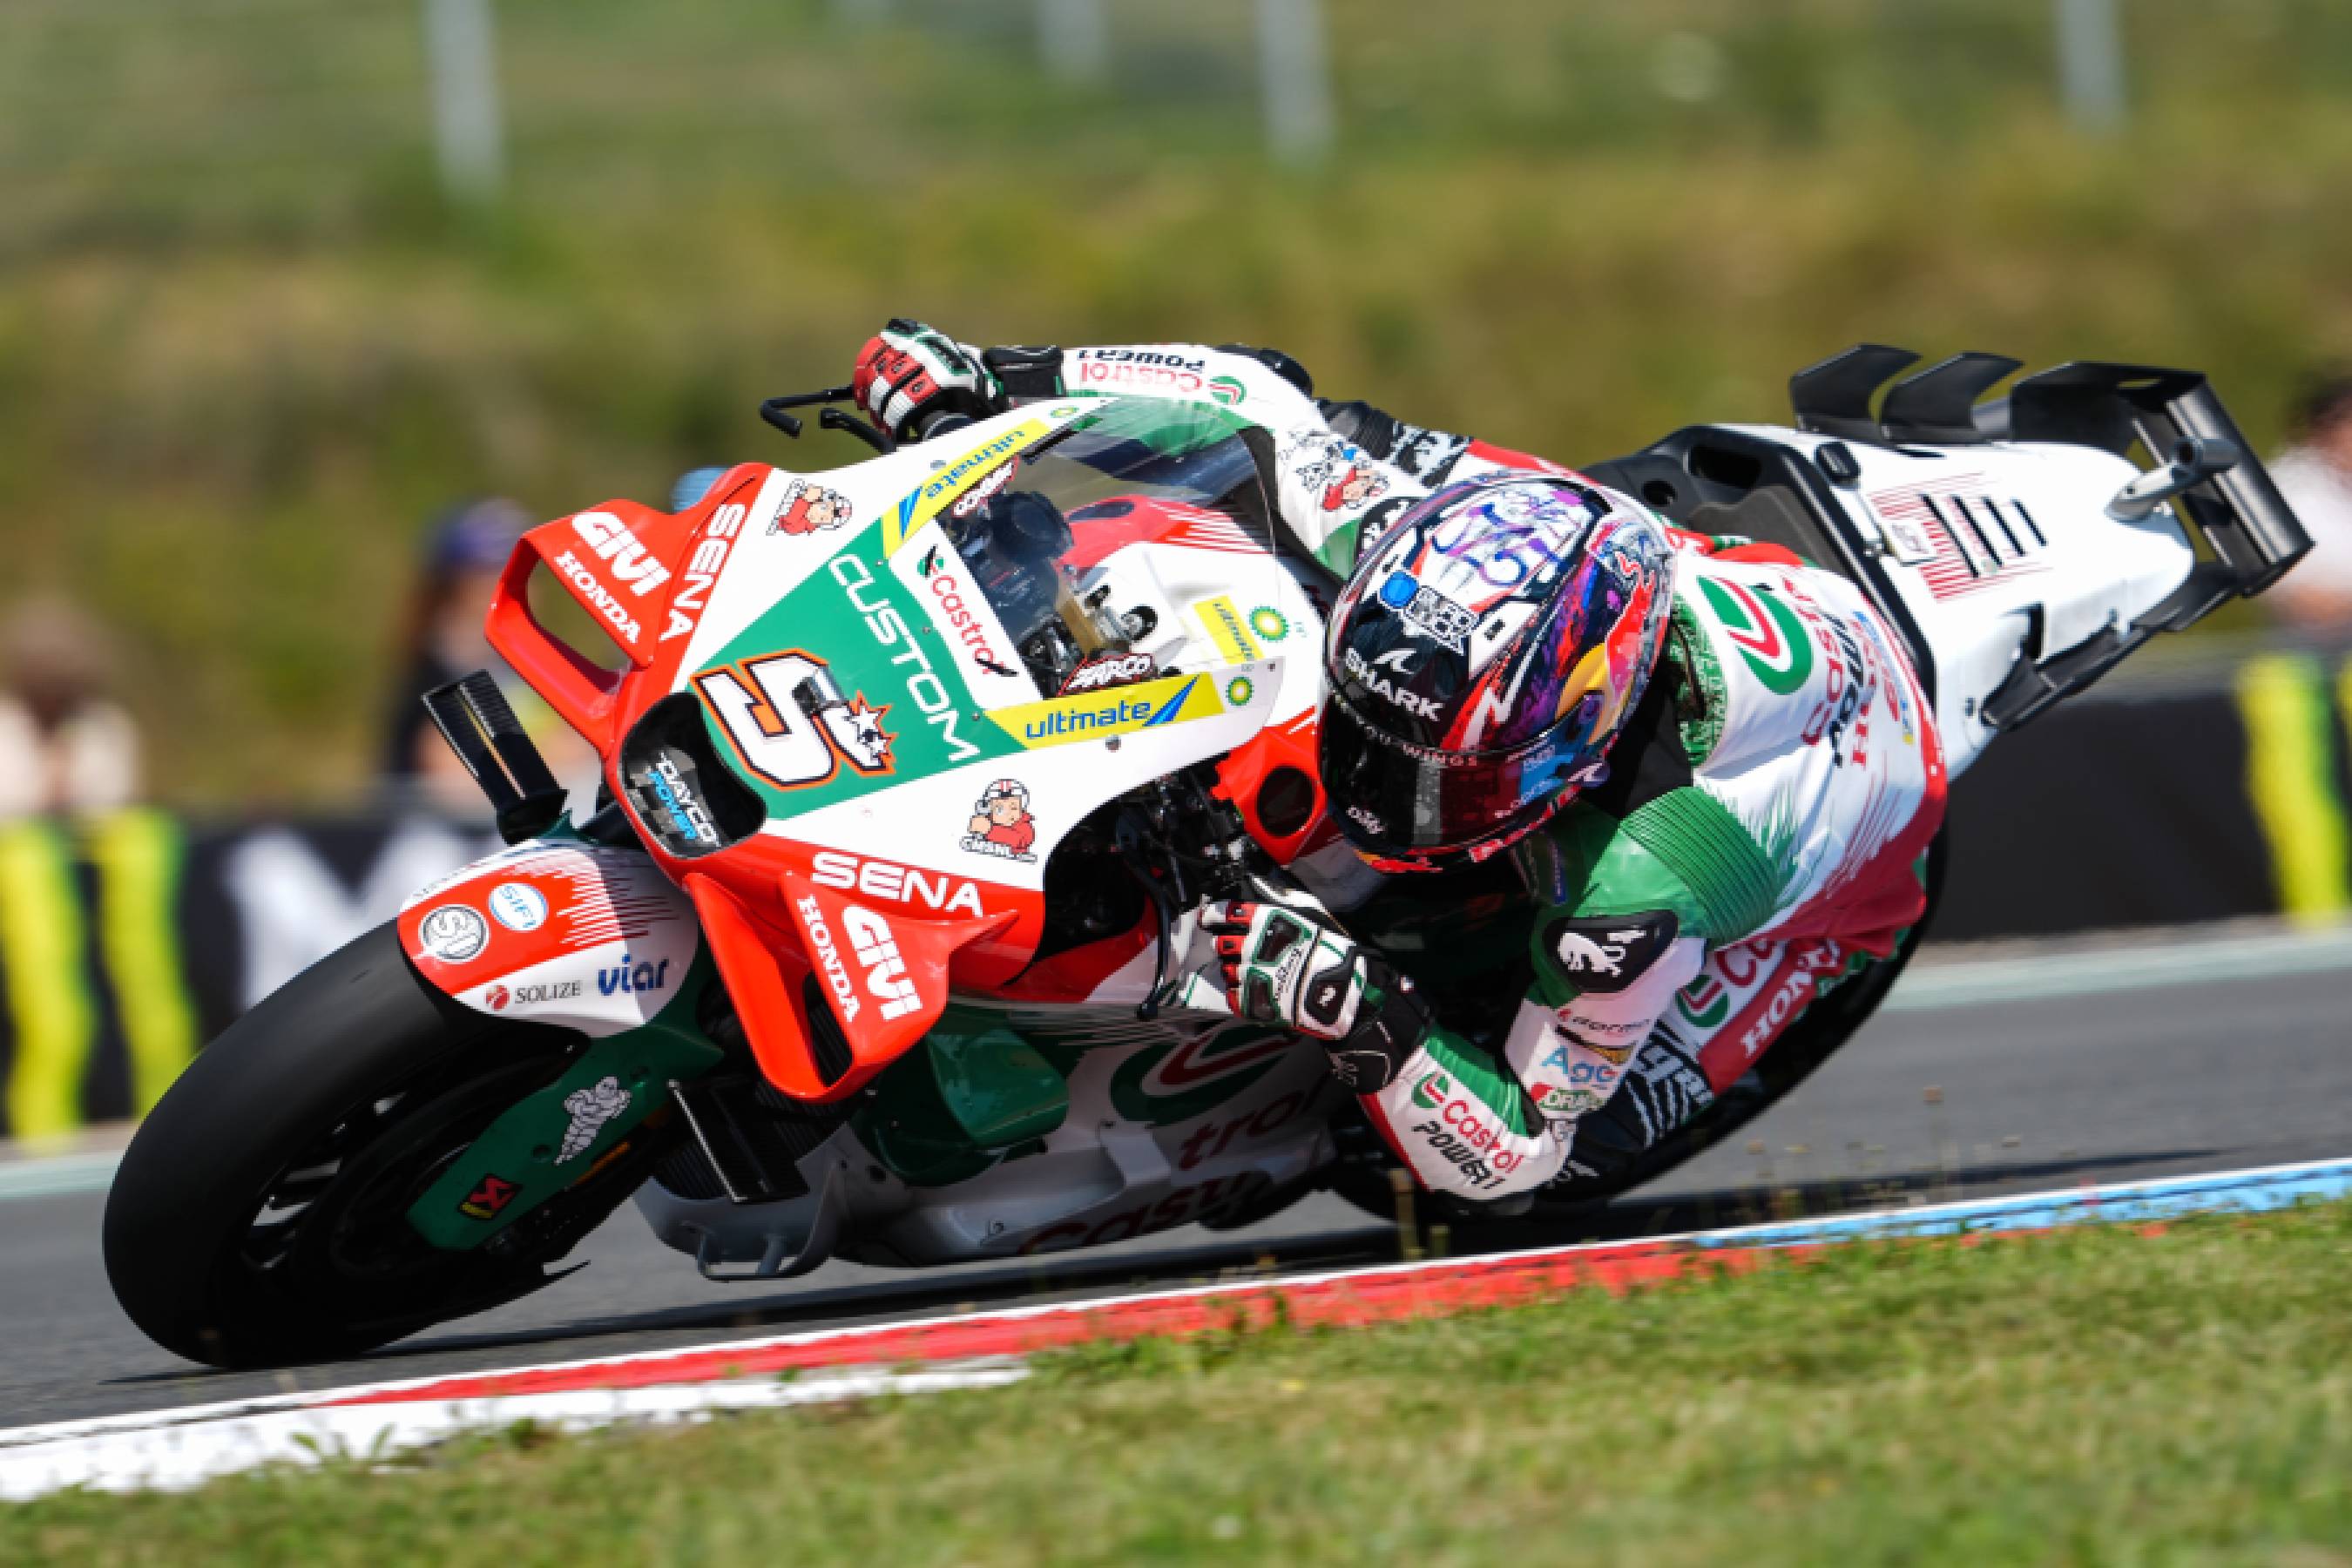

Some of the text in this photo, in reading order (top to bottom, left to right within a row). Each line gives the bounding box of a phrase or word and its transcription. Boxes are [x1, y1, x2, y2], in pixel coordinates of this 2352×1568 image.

[1081, 362, 1202, 392] Castrol
[925, 429, 1025, 499] ultimate
[571, 511, 670, 596] GIVI
[659, 503, 747, 641] SENA
[556, 551, 641, 643] HONDA
[829, 553, 980, 762] CUSTOM
[1345, 646, 1443, 722] SHARK
[1027, 700, 1151, 739] ultimate
[656, 760, 718, 842] DAYCO
[812, 851, 983, 917] SENA
[514, 980, 582, 1004] SOLIZE
[797, 895, 861, 1022] HONDA
[843, 906, 923, 1021] GIVI
[1413, 1119, 1506, 1190] POWER1
[1442, 1098, 1523, 1174] Castrol
